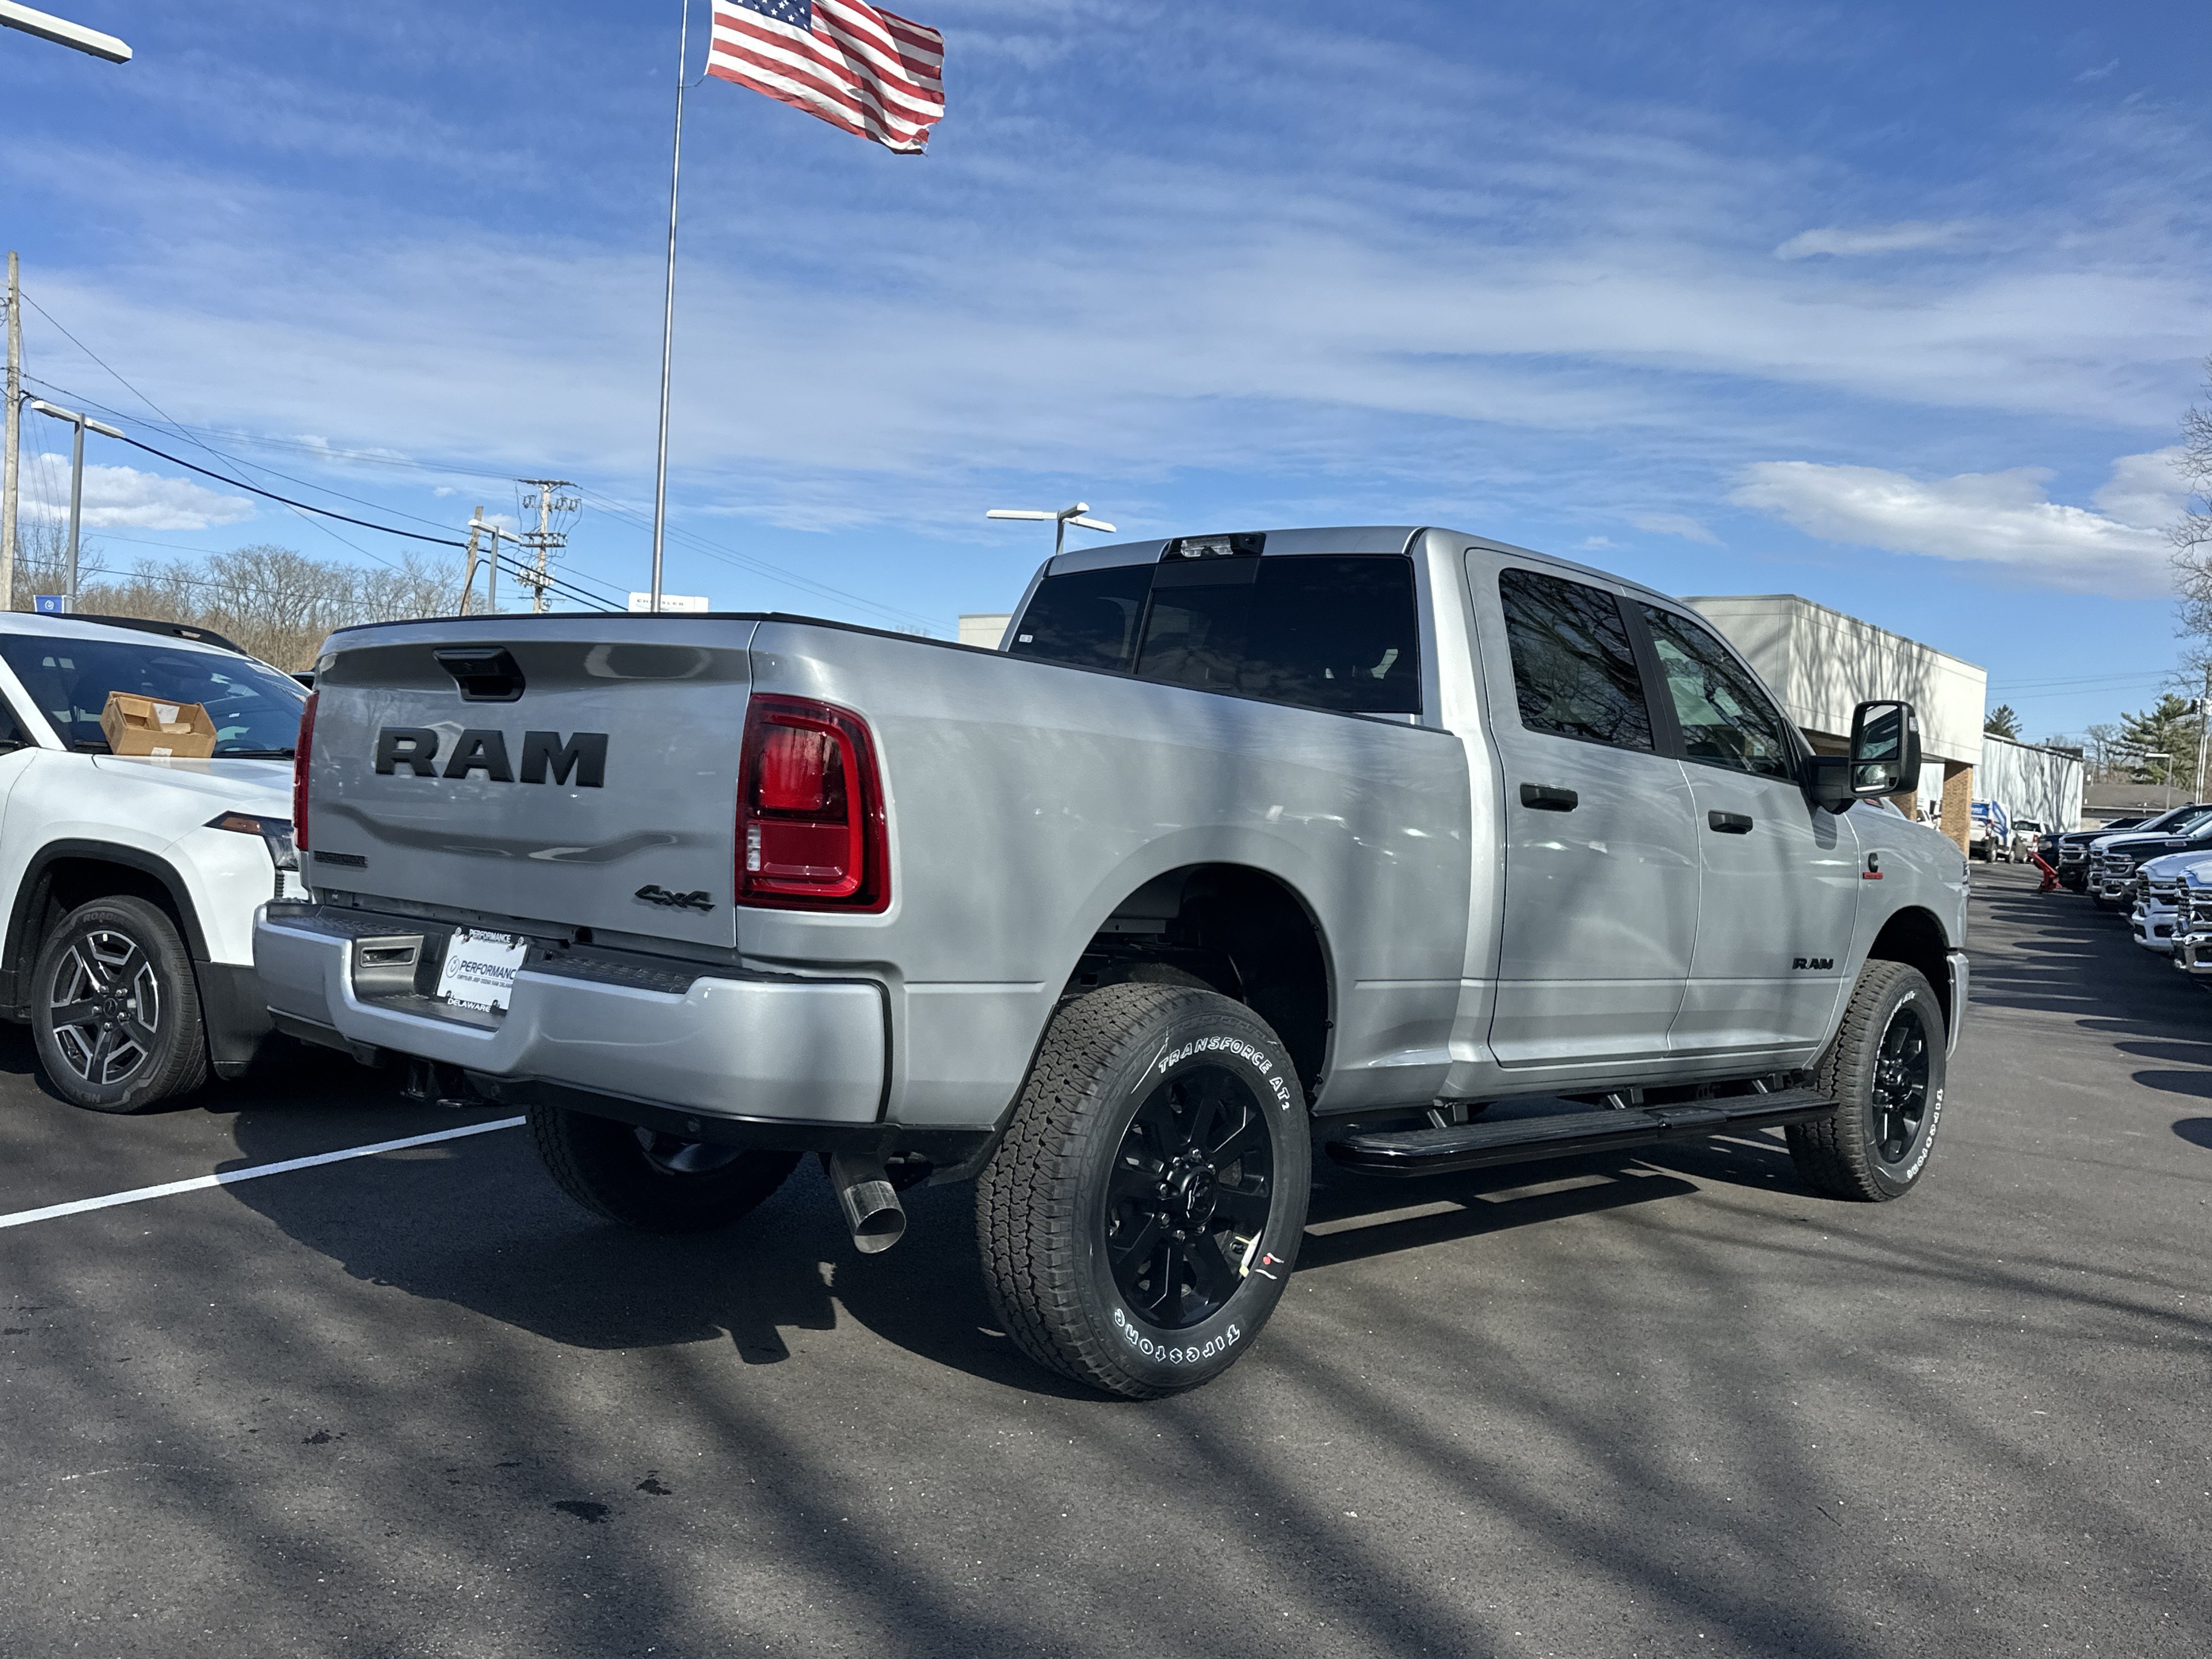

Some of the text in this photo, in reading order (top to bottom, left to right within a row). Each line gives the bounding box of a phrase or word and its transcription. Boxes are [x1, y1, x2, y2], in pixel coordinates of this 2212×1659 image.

[375, 726, 608, 788] RAM
[634, 884, 715, 912] 4x4
[469, 928, 511, 943] PERFORMANCE
[459, 960, 516, 980] PERFORMANC
[1792, 957, 1834, 970] RAM
[447, 998, 491, 1013] DELAWARE
[1158, 1036, 1273, 1075] TRANSFORCE
